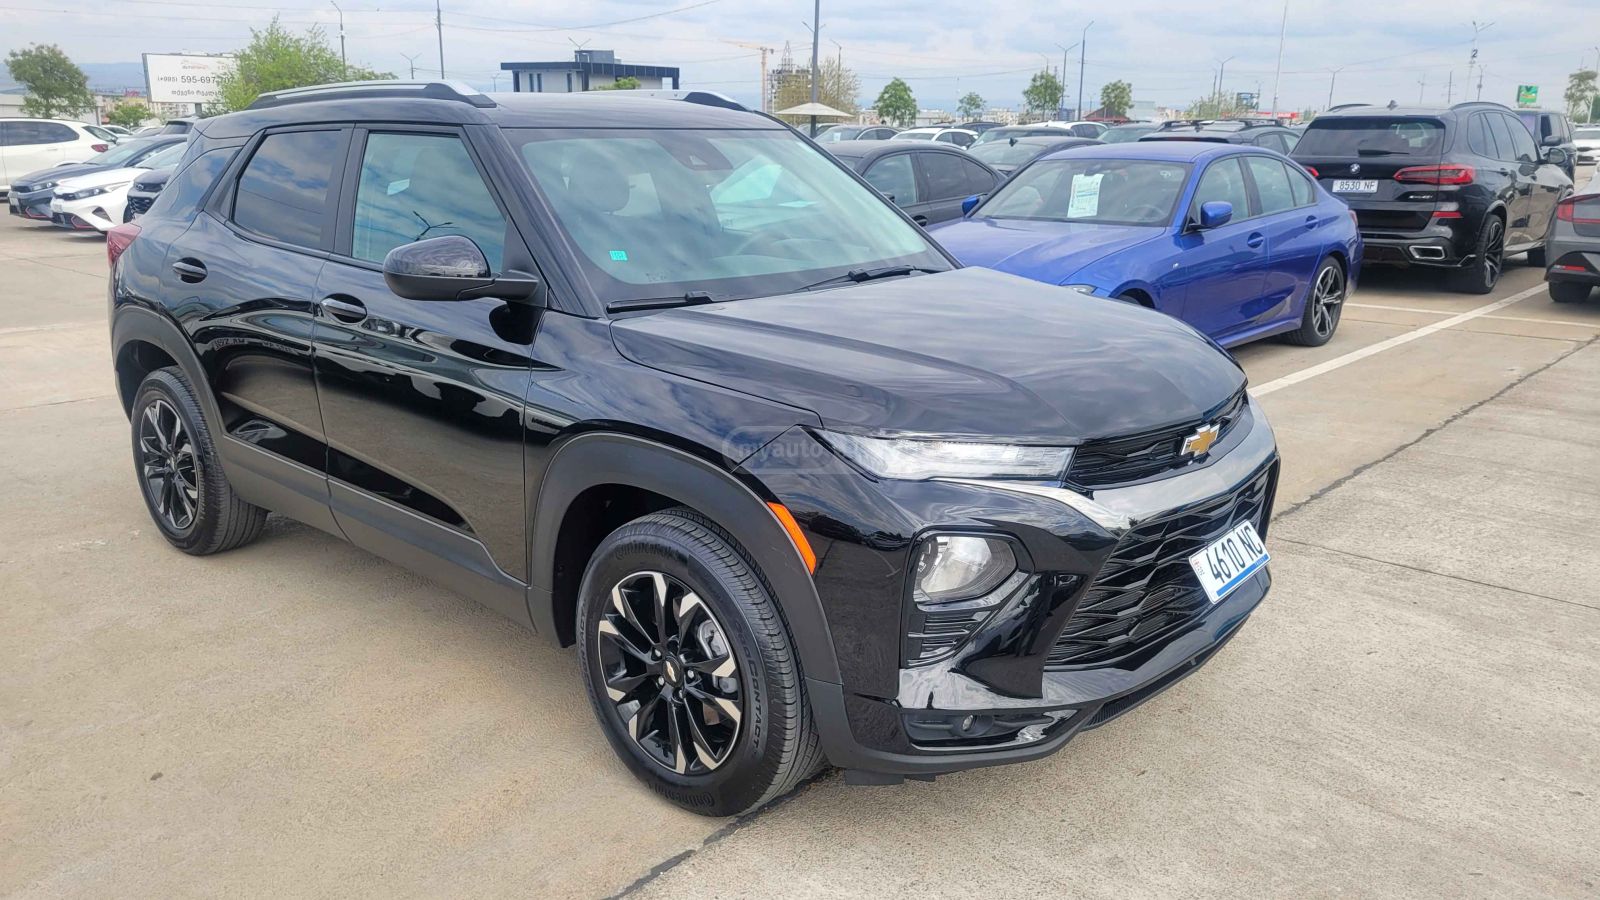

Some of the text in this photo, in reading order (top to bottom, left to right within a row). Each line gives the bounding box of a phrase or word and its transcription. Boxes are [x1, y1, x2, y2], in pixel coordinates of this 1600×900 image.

[1340, 181, 1376, 190] 8530 NF
[1205, 537, 1246, 584] 4610
[1236, 525, 1264, 562] NC
